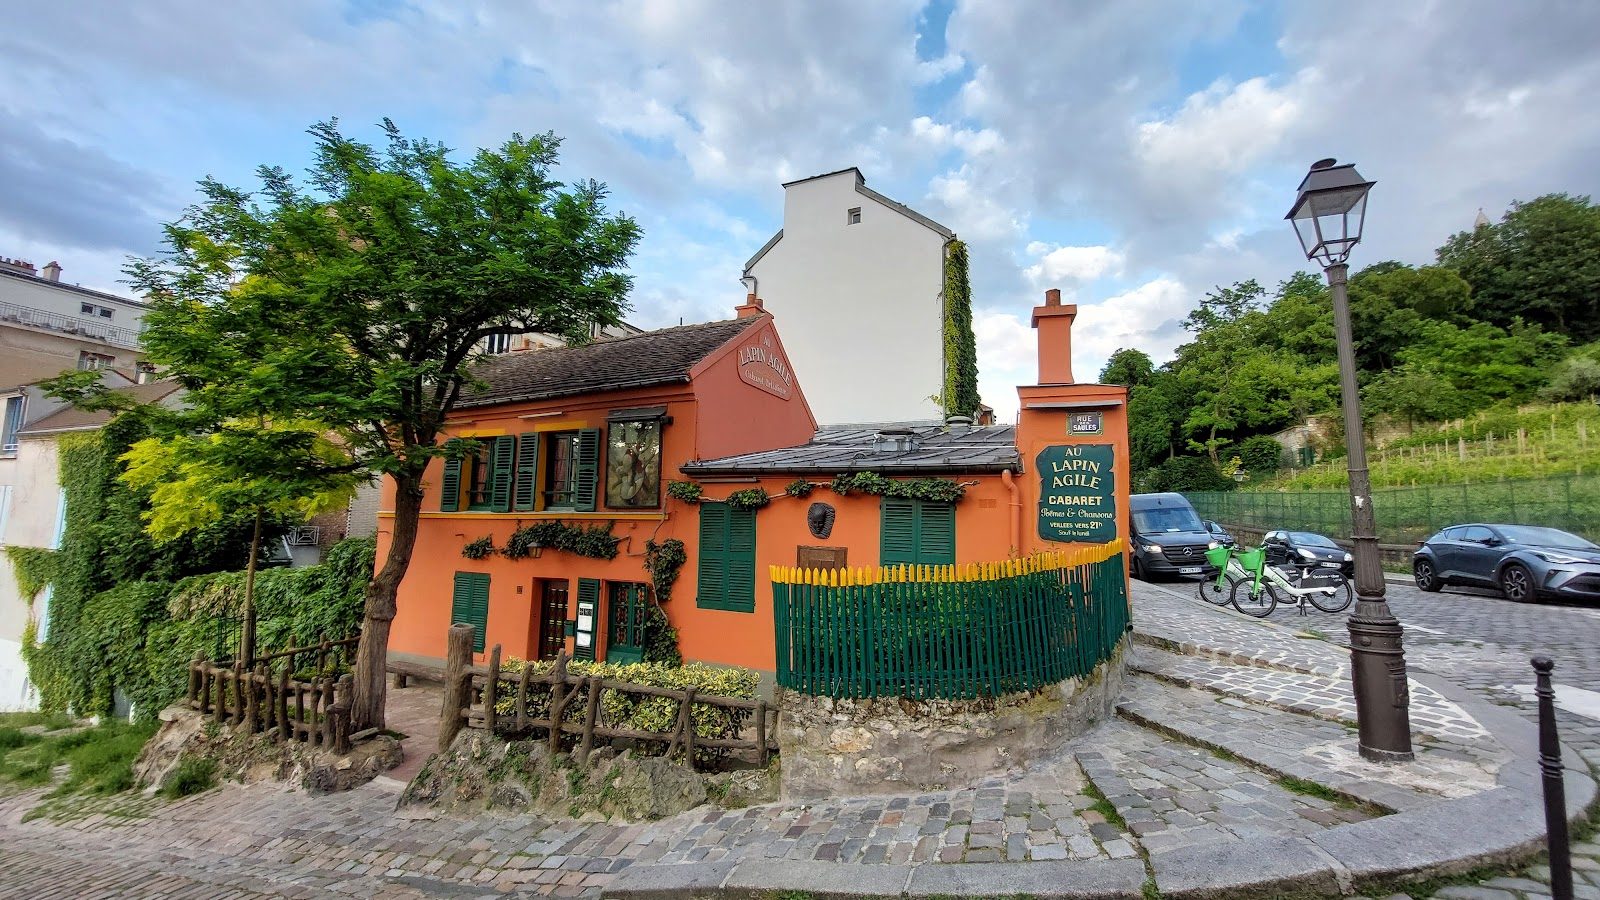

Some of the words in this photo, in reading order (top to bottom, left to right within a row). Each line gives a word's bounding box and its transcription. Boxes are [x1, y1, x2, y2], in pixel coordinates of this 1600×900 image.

[740, 347, 766, 366] LAPIN
[767, 353, 790, 386] AGILE
[1065, 447, 1082, 457] AU
[1051, 459, 1100, 474] LAPIN
[1052, 474, 1101, 489] AGILE
[1049, 495, 1103, 505] CABARET
[1067, 507, 1075, 517] &
[1078, 508, 1113, 518] Chansons
[1090, 521, 1103, 529] 21h
